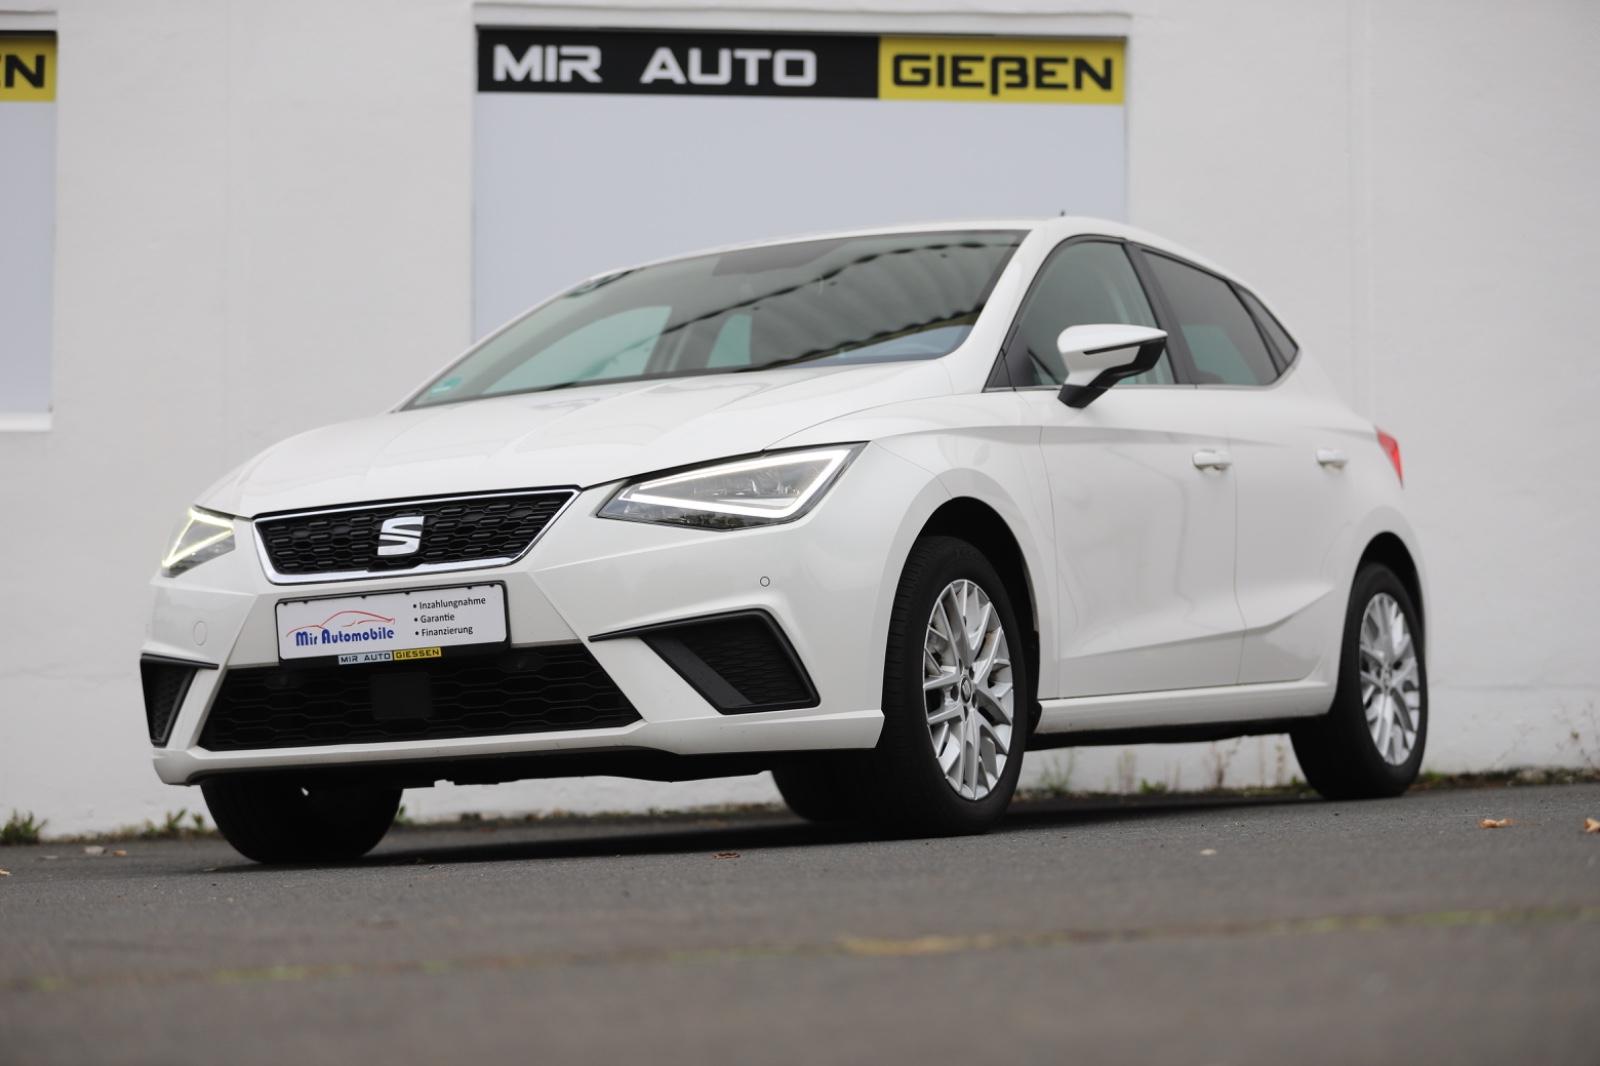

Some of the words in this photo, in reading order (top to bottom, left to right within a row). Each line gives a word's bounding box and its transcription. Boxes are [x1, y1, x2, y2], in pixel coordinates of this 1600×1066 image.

[0, 54, 46, 89] N
[493, 44, 602, 83] MIR
[640, 47, 817, 87] AUTO
[892, 54, 1113, 96] GIEßEN
[419, 596, 486, 611] Inzahlungnahme
[420, 613, 455, 624] Garantie
[296, 631, 318, 646] Mir
[321, 627, 395, 645] Automobile
[421, 625, 474, 637] Finanzierung
[340, 655, 359, 664] MIR
[364, 652, 391, 662] AUTO
[395, 648, 440, 659] GIESSEN
